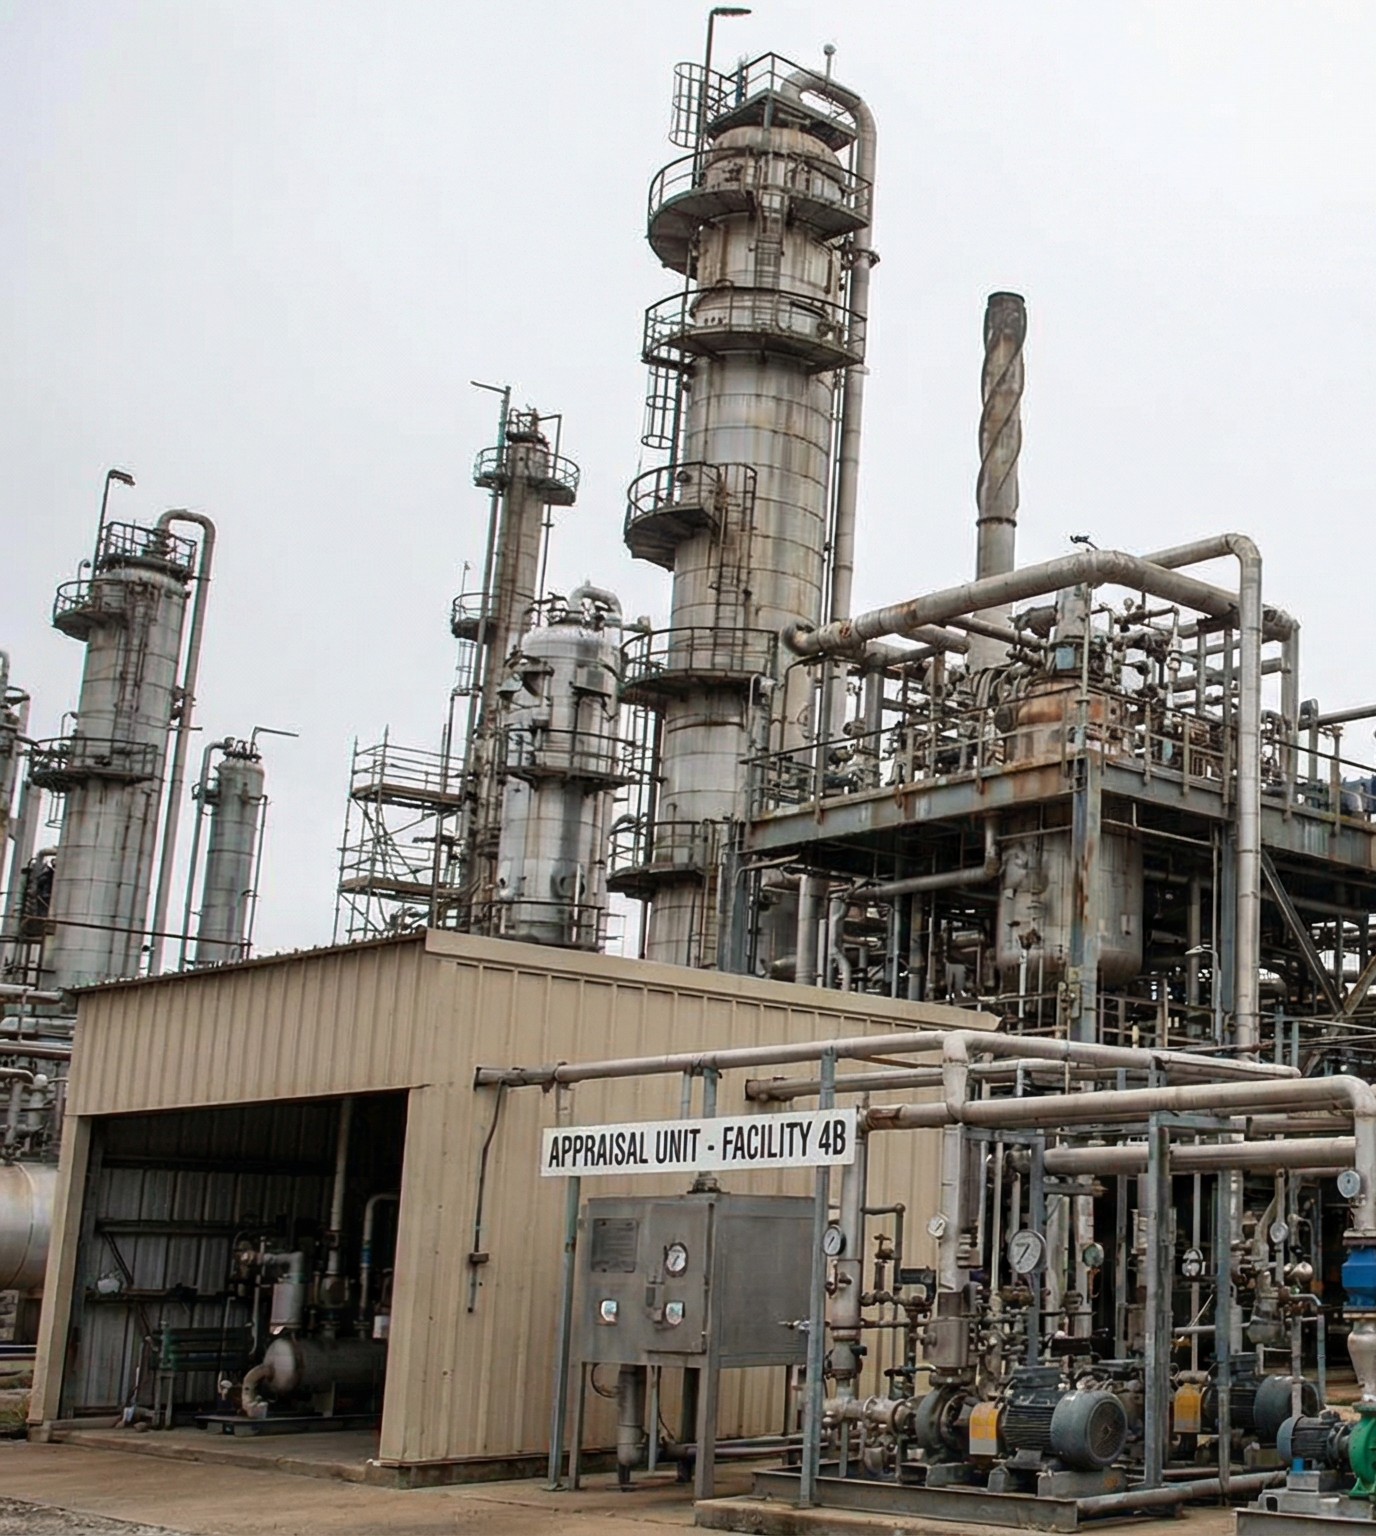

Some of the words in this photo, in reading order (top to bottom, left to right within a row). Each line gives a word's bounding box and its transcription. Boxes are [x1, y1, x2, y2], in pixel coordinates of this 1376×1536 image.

[548, 1131, 648, 1168] APPRAISAL
[655, 1128, 701, 1164] UNIT
[722, 1121, 813, 1161] FACILITY
[818, 1119, 846, 1156] 4B
